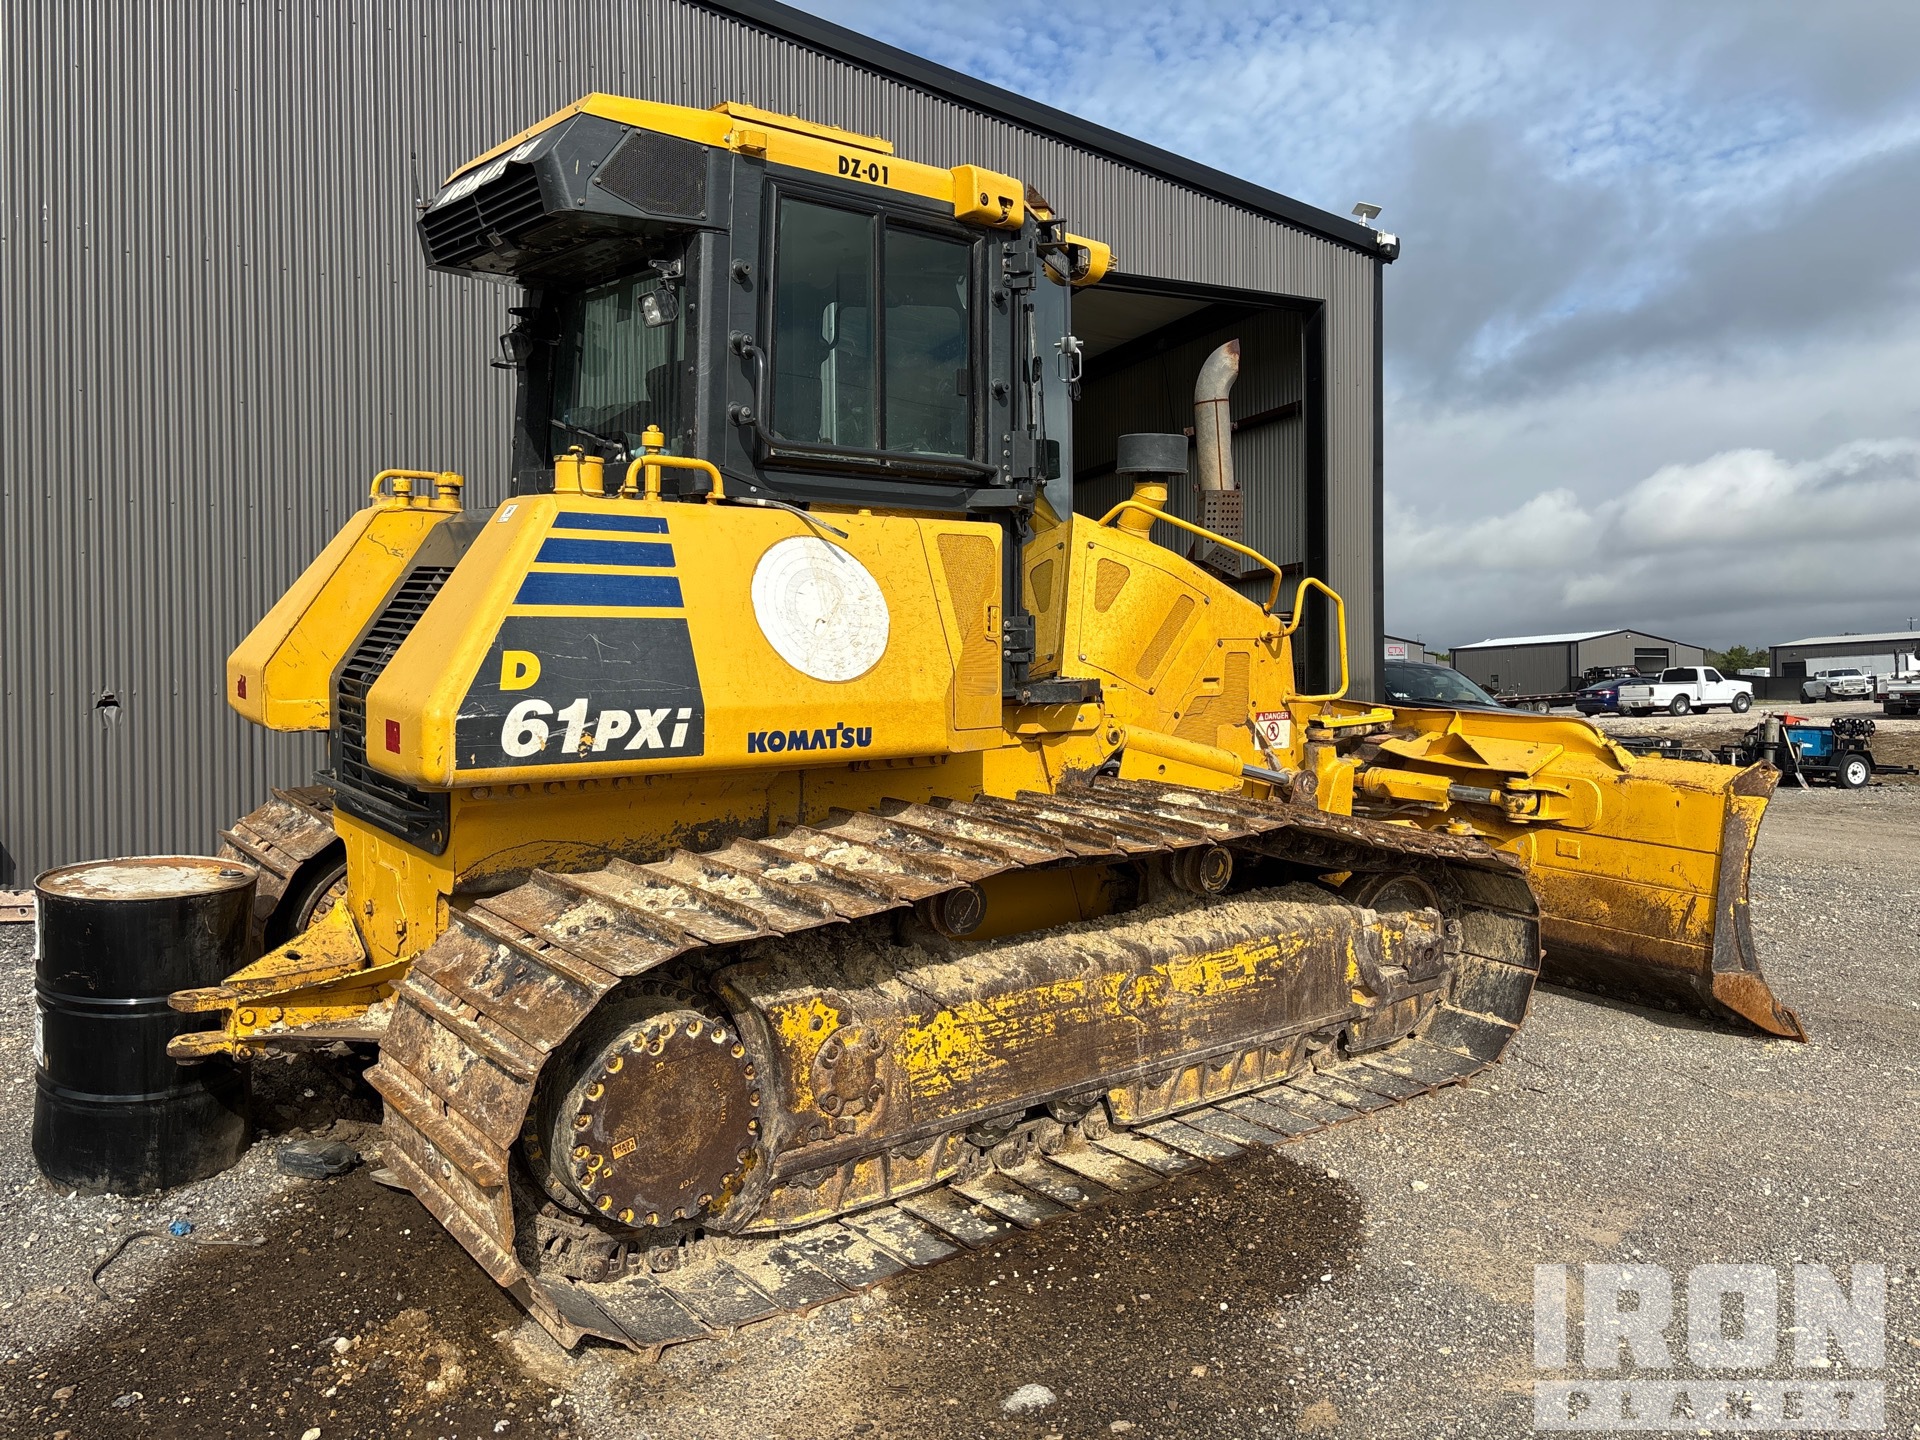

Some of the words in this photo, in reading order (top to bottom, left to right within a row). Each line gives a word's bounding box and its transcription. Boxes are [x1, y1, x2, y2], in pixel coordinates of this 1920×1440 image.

[838, 154, 889, 185] DZ-01
[1387, 646, 1404, 654] CTX
[499, 650, 541, 691] D
[1264, 711, 1289, 720] DANGER
[747, 722, 872, 753] KOMATSU
